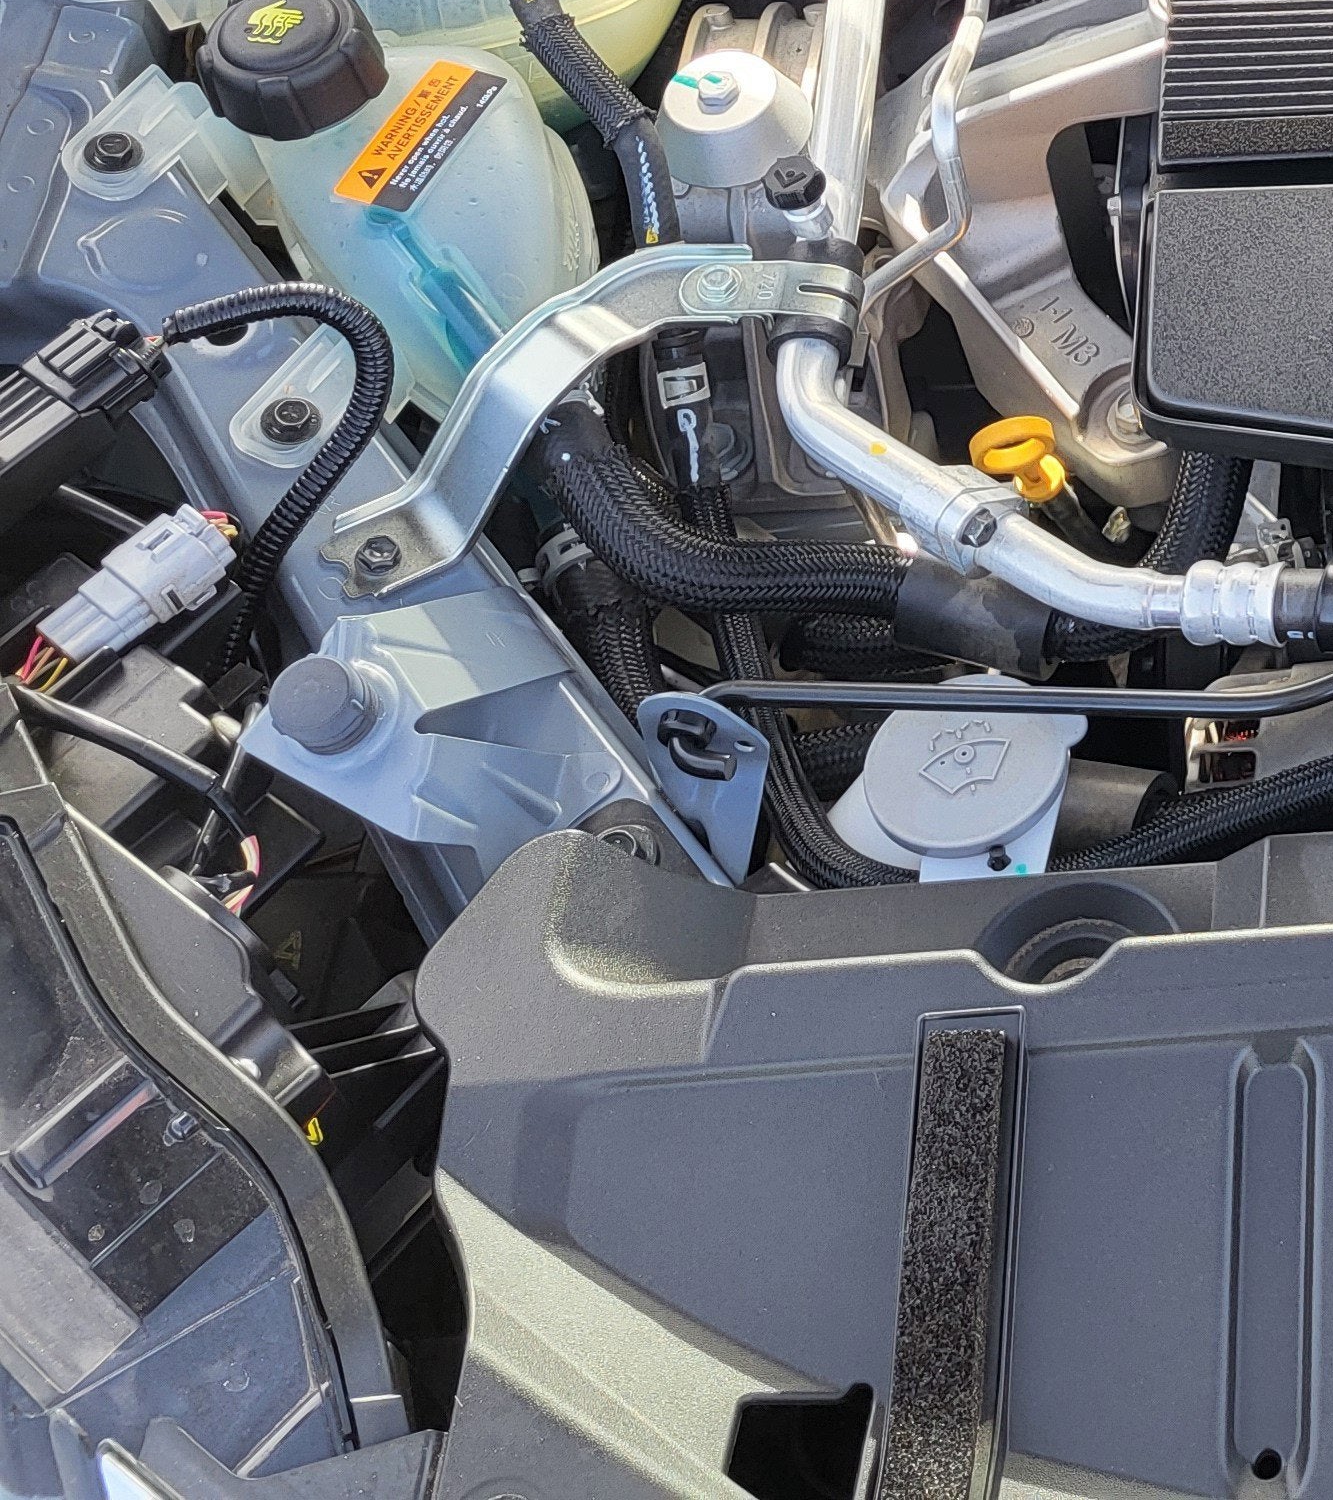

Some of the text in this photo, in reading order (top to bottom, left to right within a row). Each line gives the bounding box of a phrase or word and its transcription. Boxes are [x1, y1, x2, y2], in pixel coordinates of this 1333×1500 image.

[371, 105, 416, 157] WARNING
[387, 75, 459, 160] AVERTISSEMENT
[399, 176, 411, 189] Ne
[410, 152, 430, 179] jamais
[428, 132, 446, 154] ouvrir
[448, 105, 469, 130] chaud.
[389, 165, 410, 185] Never
[408, 143, 424, 165] open
[422, 125, 440, 146] when
[436, 114, 451, 132] hot.
[757, 271, 778, 300] 720
[1049, 323, 1100, 366] M3
